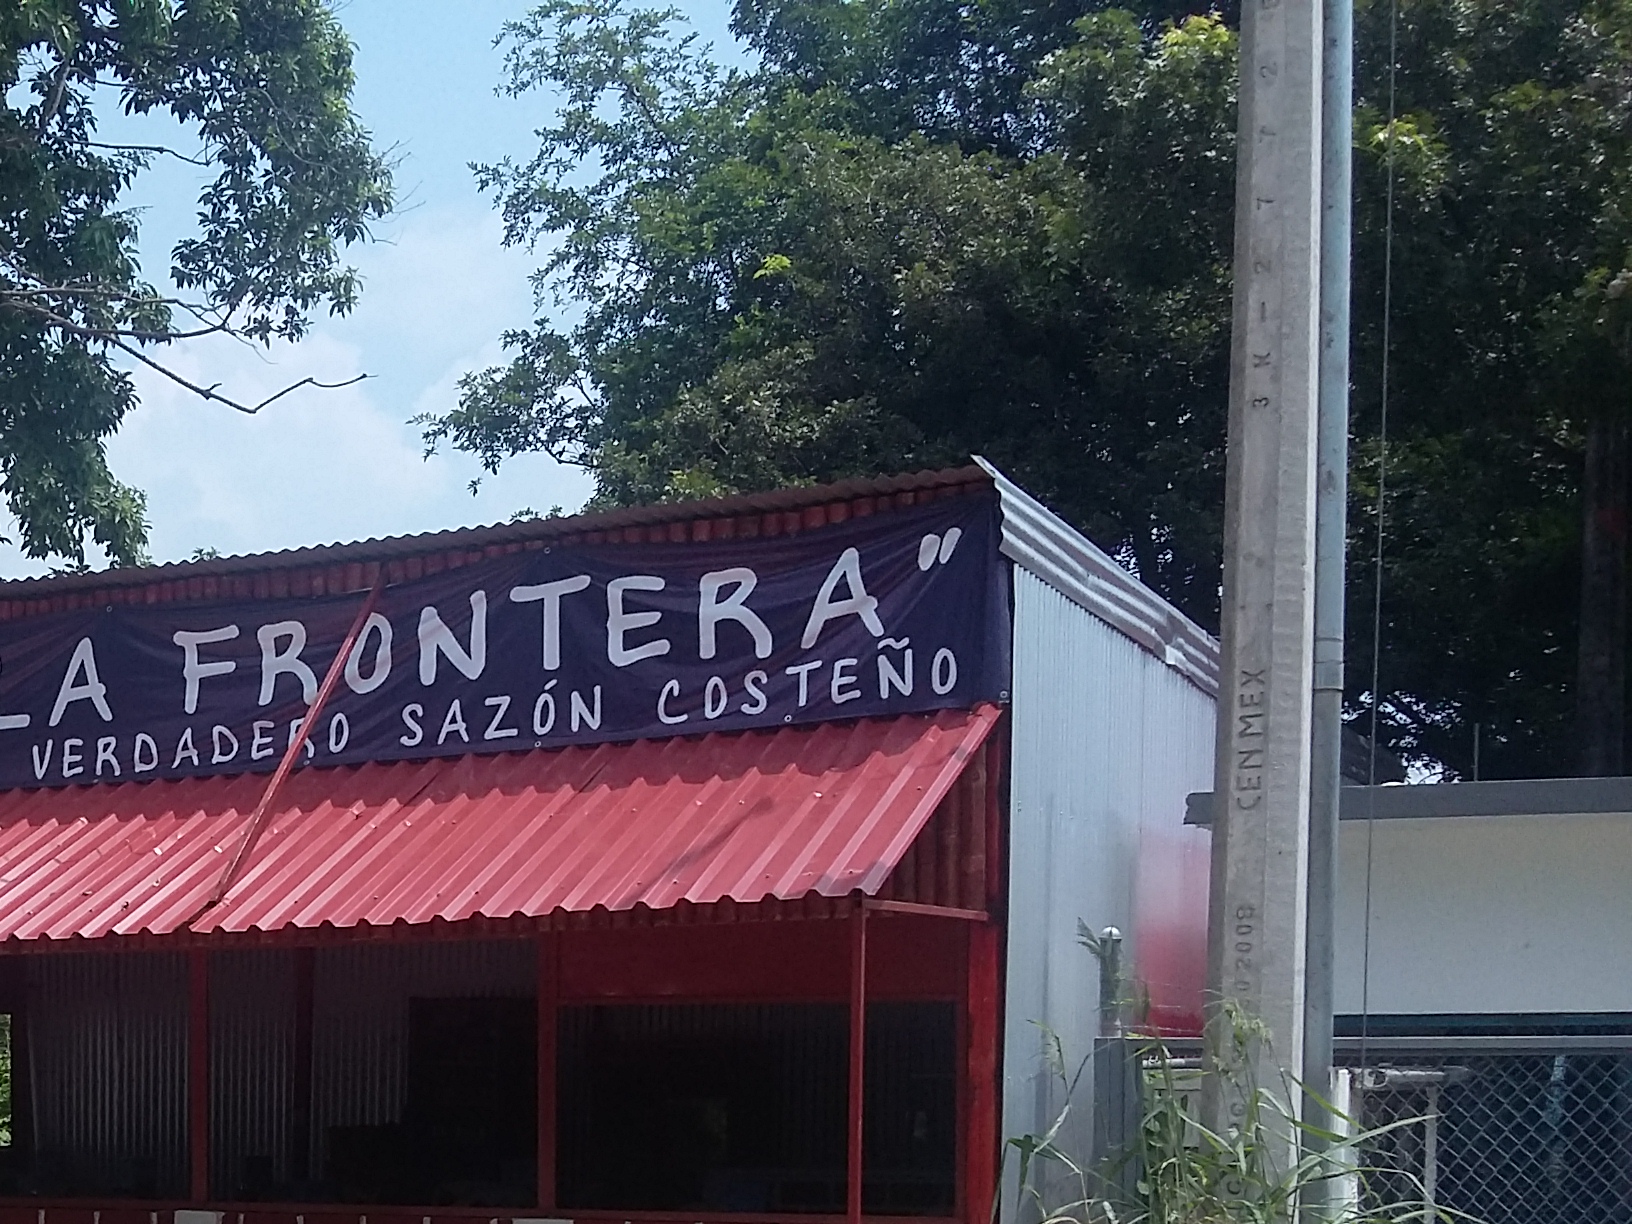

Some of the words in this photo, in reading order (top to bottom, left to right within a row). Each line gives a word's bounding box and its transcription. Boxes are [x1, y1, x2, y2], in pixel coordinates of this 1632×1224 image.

[31, 712, 349, 780] VERDADERO
[400, 679, 602, 747] SAZÓN
[658, 637, 958, 724] COSTEÑO
